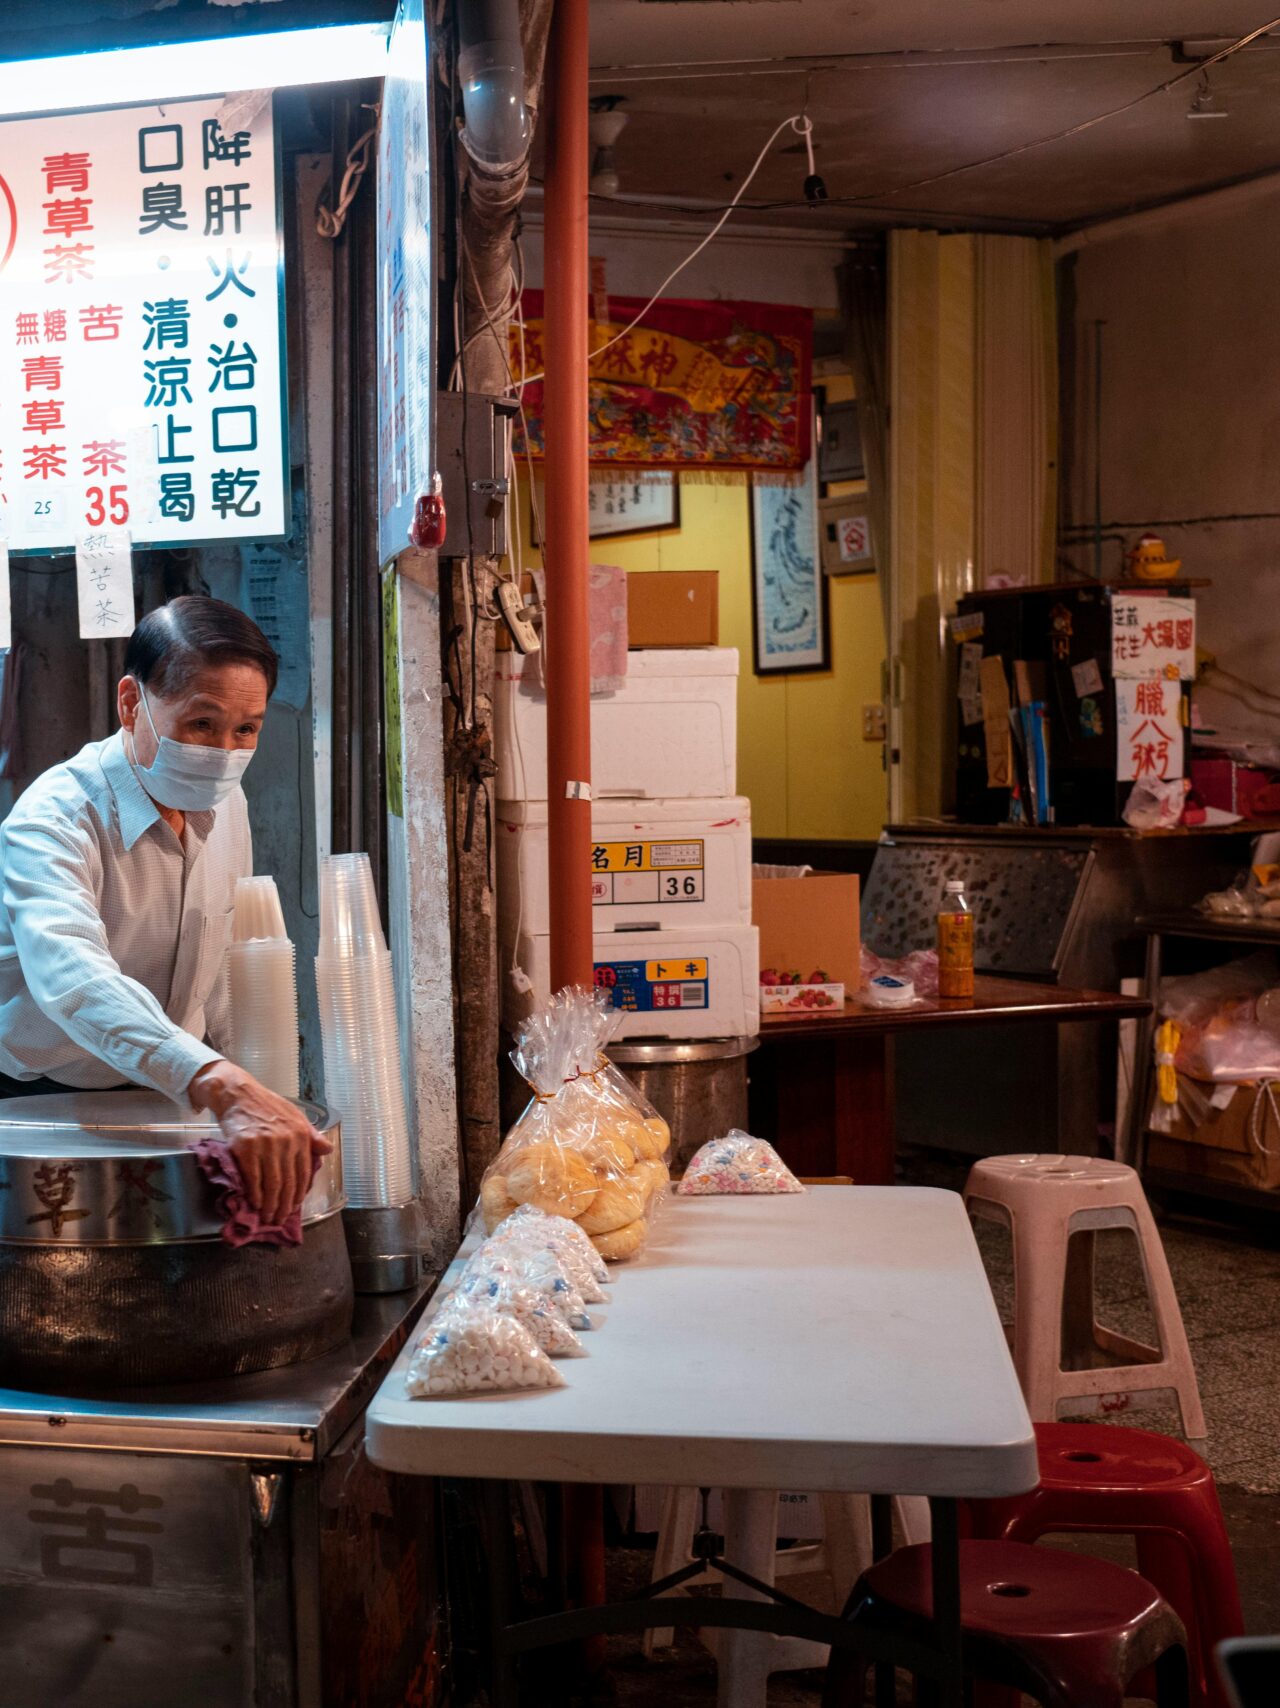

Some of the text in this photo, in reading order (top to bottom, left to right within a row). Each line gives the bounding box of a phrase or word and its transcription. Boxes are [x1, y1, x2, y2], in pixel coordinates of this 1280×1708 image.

[40, 151, 96, 285] 青草茶
[15, 308, 67, 346] 無糖
[77, 303, 128, 477] 苦茶
[20, 355, 67, 481] 青草茶
[33, 500, 53, 515] 25
[84, 484, 130, 527] 35
[666, 876, 696, 897] 36
[657, 962, 699, 978] トキ
[656, 996, 676, 1007] 36
